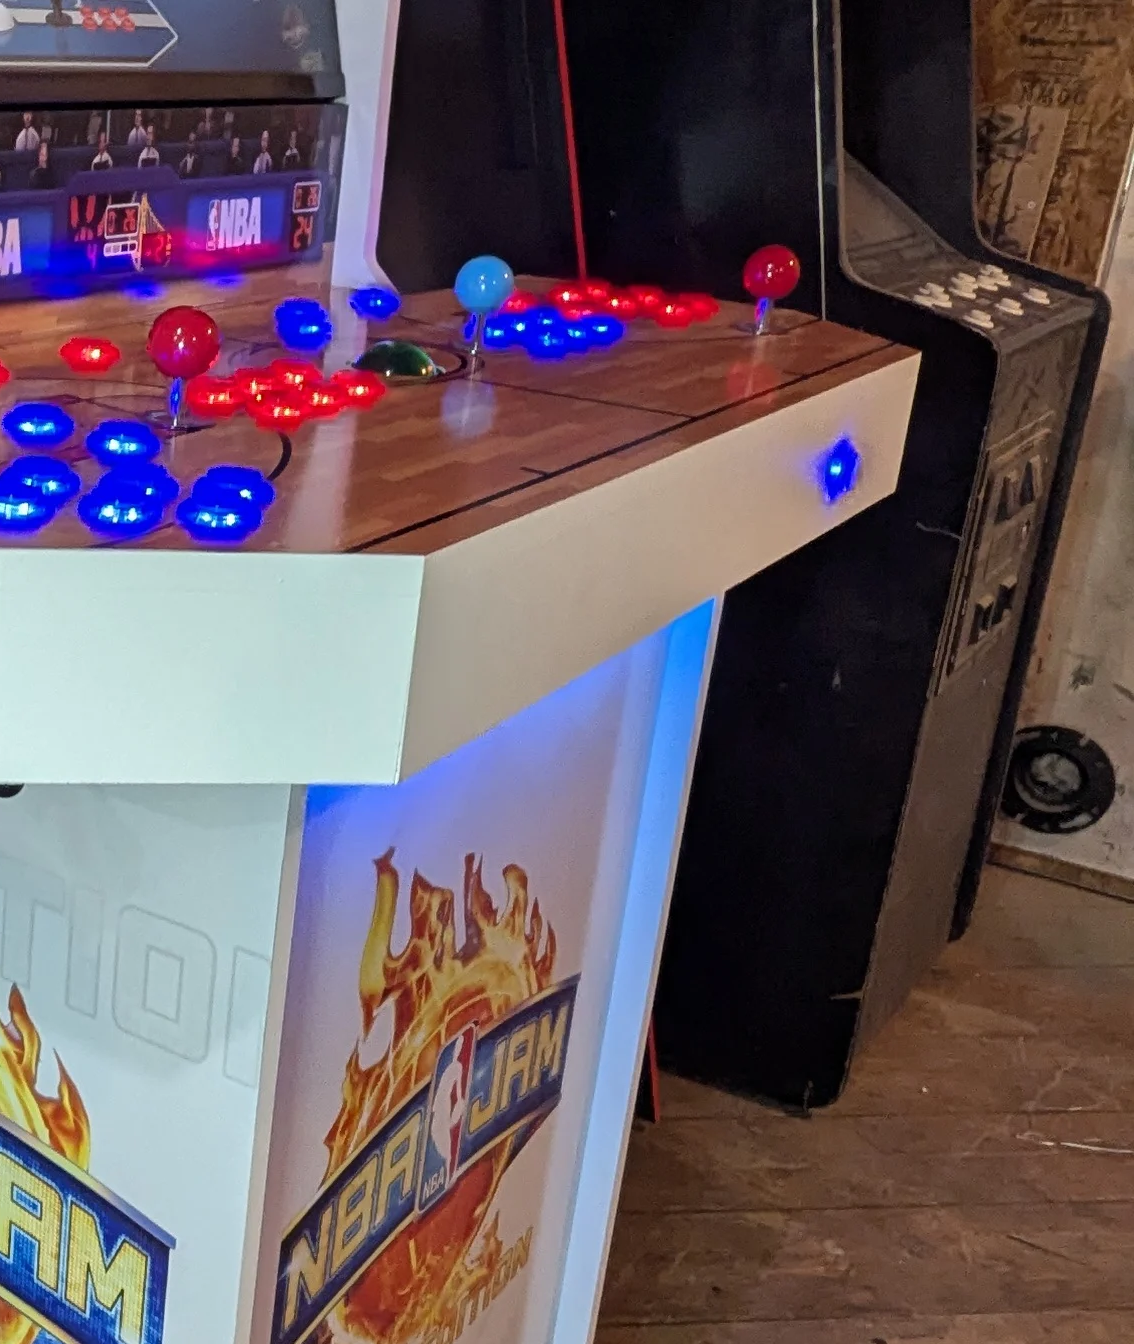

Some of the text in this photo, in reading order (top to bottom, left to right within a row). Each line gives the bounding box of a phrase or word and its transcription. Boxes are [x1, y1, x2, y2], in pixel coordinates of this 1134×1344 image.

[217, 196, 262, 250] NBA
[283, 1009, 567, 1329] NBA JAM
[422, 1172, 447, 1199] NBA
